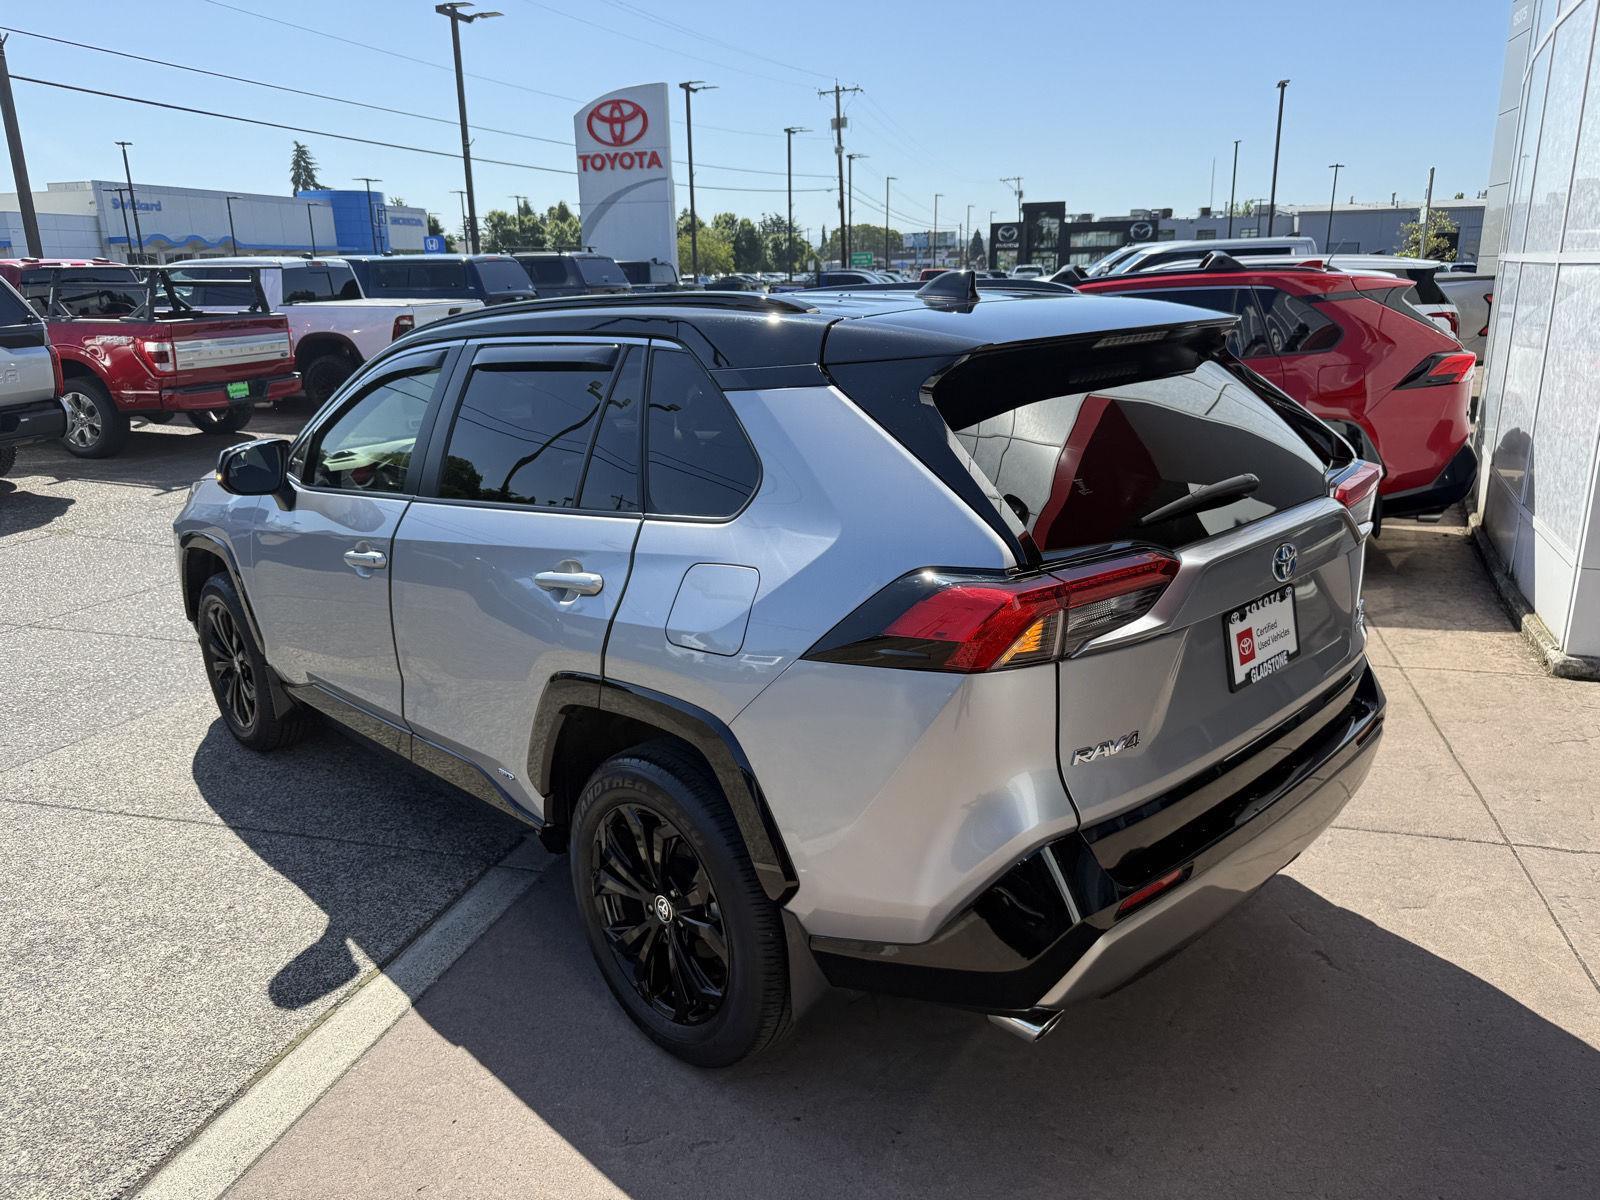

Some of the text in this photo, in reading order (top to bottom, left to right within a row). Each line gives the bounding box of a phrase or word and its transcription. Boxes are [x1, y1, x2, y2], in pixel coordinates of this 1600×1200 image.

[577, 150, 663, 172] TOYOTA
[1245, 592, 1281, 616] TOYOTA
[1256, 619, 1278, 638] Certified
[1257, 627, 1290, 651] Used Vehicles
[1251, 652, 1289, 684] GLADSTONE
[1071, 730, 1140, 766] RAV4
